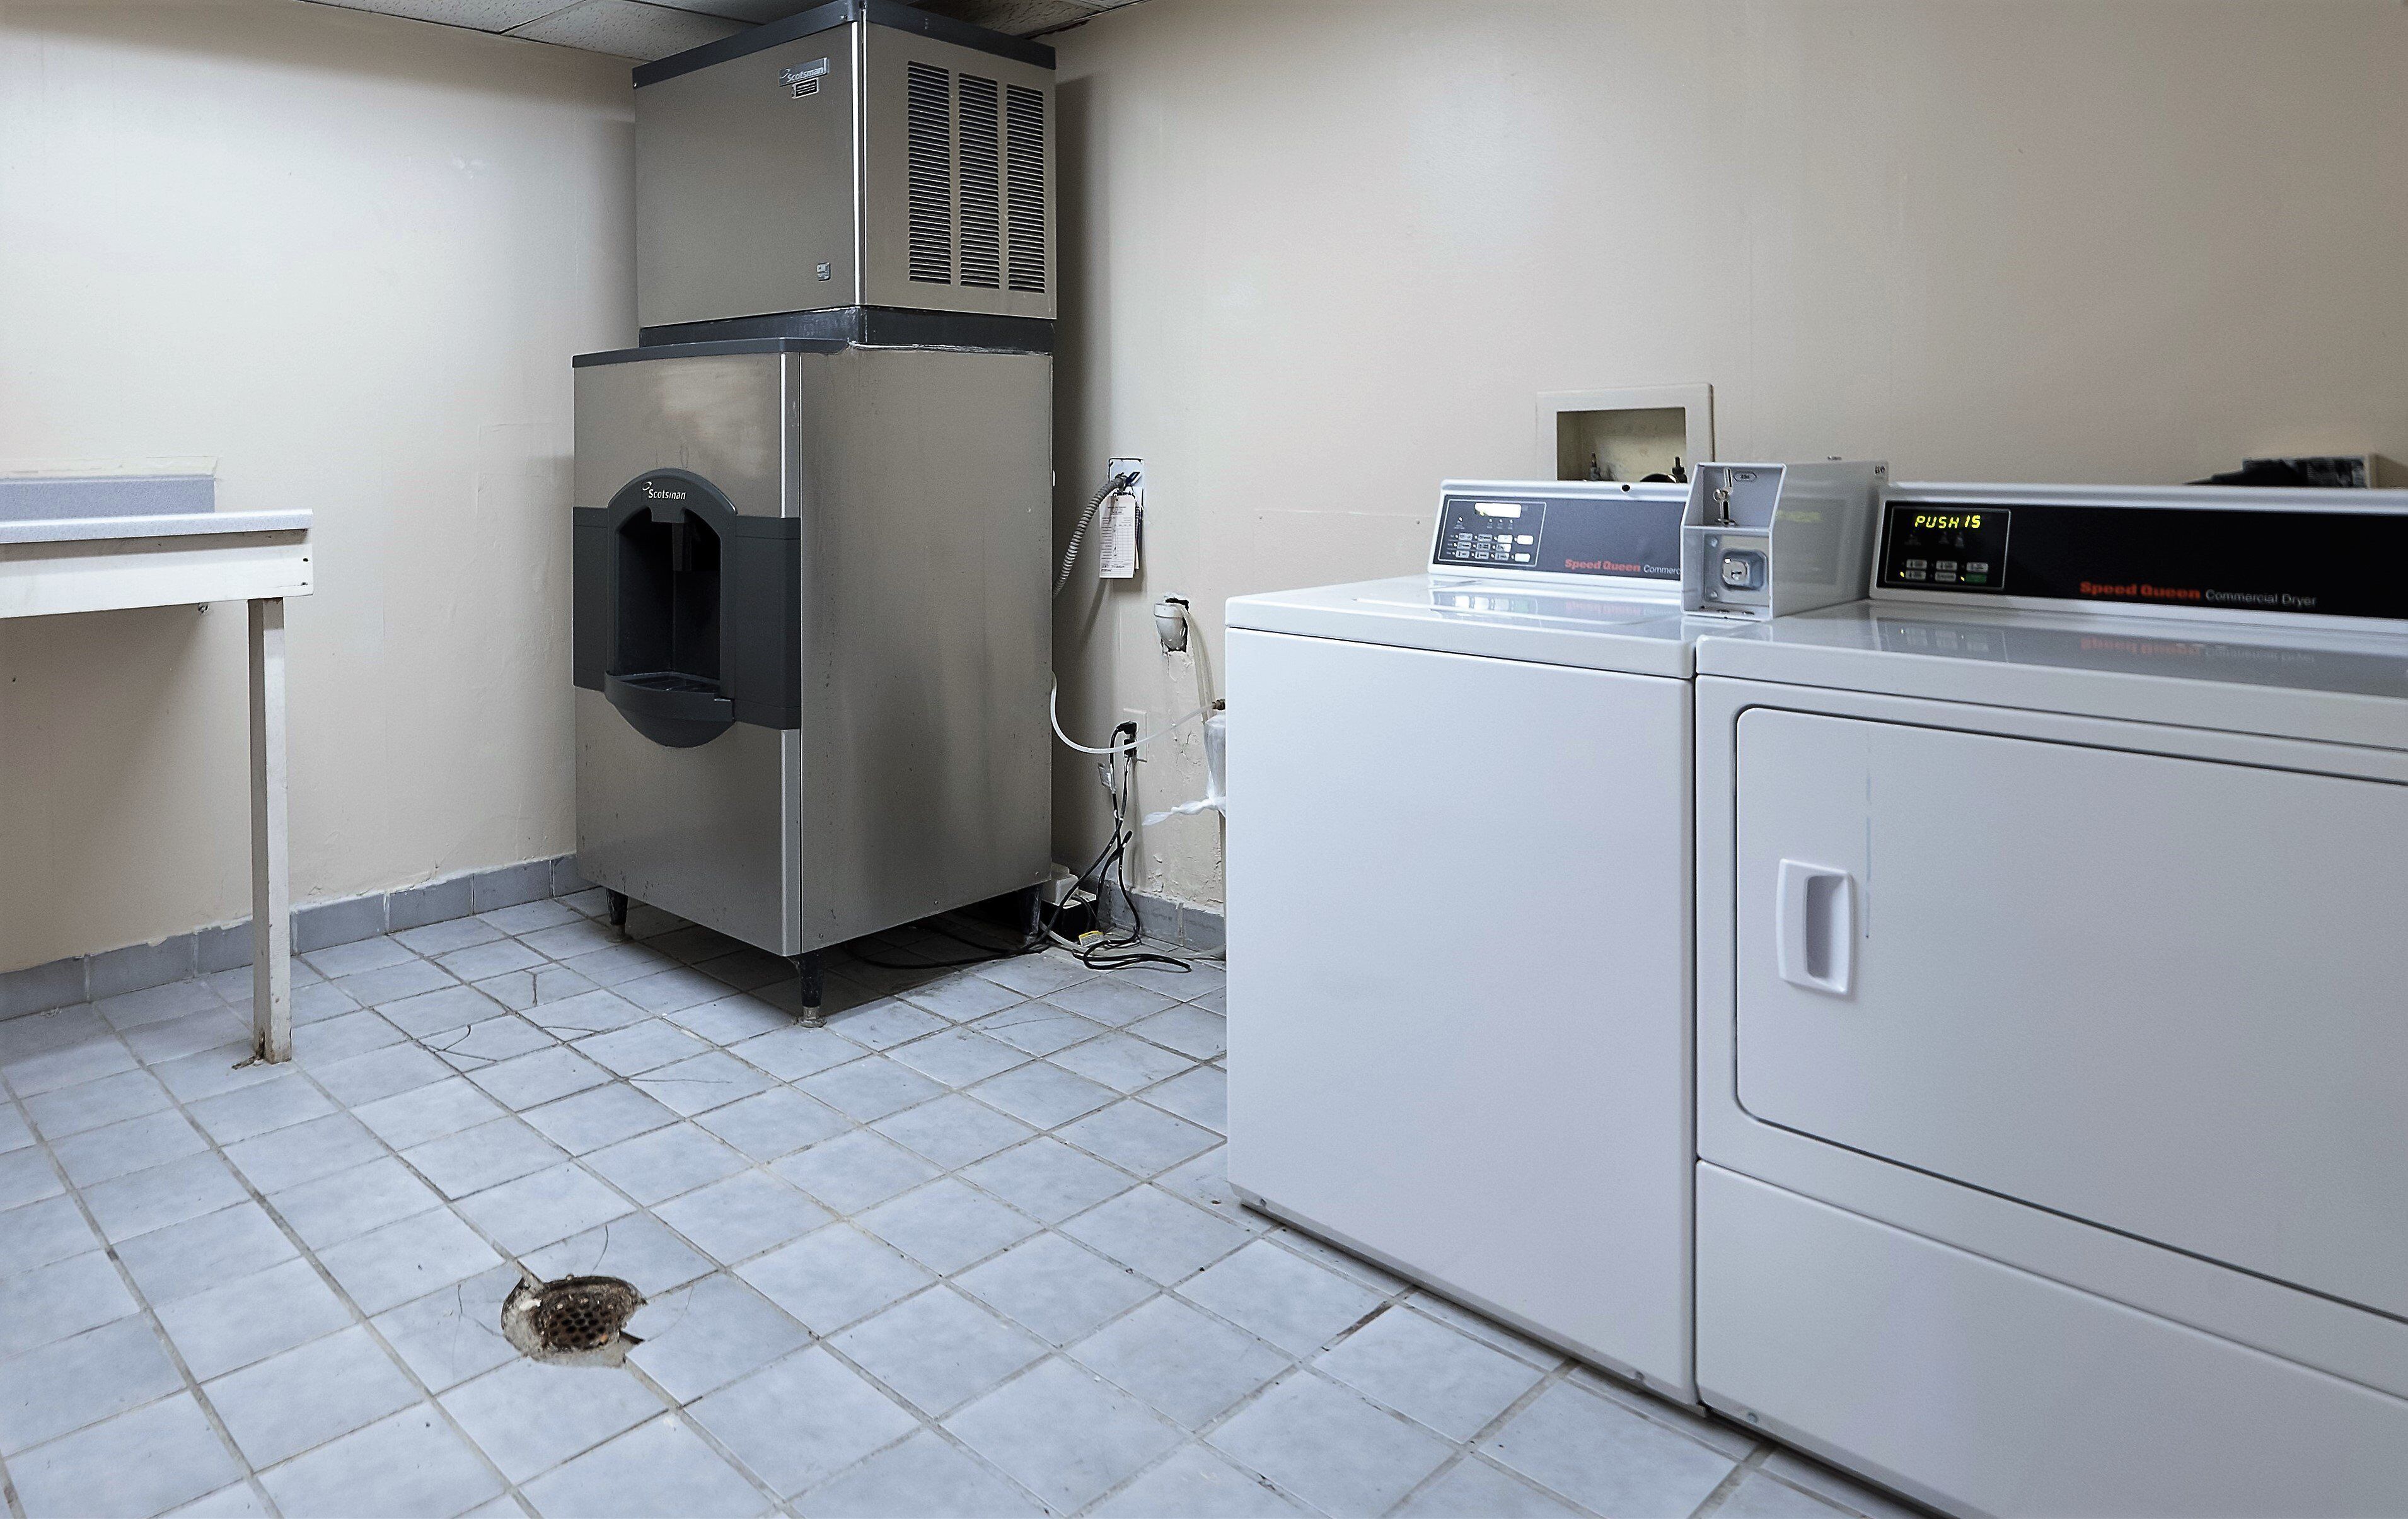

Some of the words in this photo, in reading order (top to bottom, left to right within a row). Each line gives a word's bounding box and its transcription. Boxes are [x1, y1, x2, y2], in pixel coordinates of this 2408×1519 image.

[787, 67, 824, 83] Scotsman
[648, 489, 686, 500] Scotsman
[1914, 515, 1960, 528] PUSH
[1565, 559, 1602, 570] Speed
[1602, 561, 1641, 572] Queen
[2080, 581, 2138, 596] Speed
[2140, 583, 2201, 599] Queen
[2206, 589, 2278, 604] Commercial
[2281, 593, 2317, 609] Dryer
